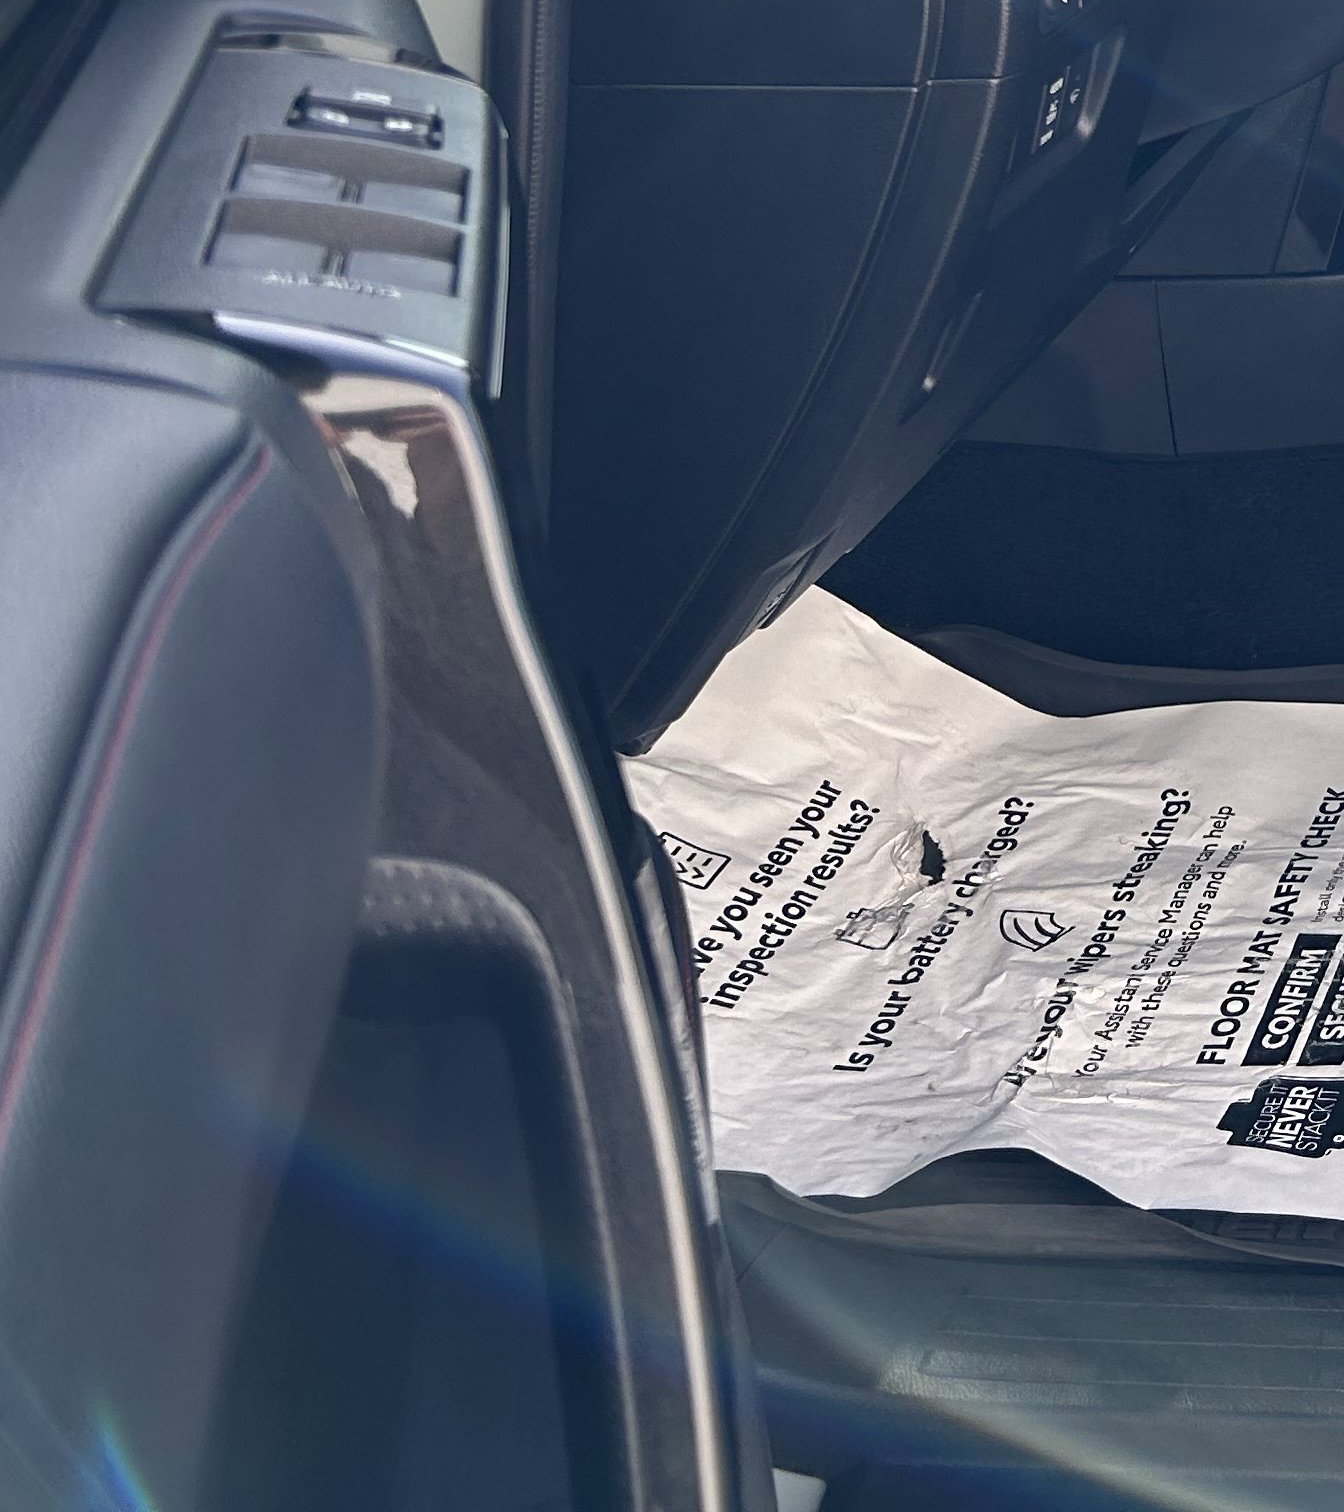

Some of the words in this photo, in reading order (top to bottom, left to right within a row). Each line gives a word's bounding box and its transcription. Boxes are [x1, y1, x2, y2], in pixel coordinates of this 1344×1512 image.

[709, 887, 763, 940] you
[749, 837, 804, 888] seen
[788, 780, 841, 839] your
[1196, 844, 1218, 862] can
[1203, 806, 1235, 838] help
[697, 890, 818, 1009] inspection
[803, 799, 880, 890] results?
[1064, 909, 1126, 974] wipers
[1112, 788, 1191, 902] streaking?
[1158, 863, 1203, 923] Manager
[833, 1052, 874, 1072] Is
[858, 991, 911, 1047] your
[887, 902, 973, 985] battery
[1125, 1016, 1155, 1047] with
[1141, 971, 1176, 1011] these
[1168, 903, 1211, 967] questions
[1203, 871, 1226, 899] and
[1196, 980, 1260, 1064] FLOOR
[1236, 930, 1282, 974] MAT
[1262, 852, 1319, 925] SAFETY
[1258, 945, 1328, 1050] CONFIRM
[1071, 1045, 1108, 1077] Your
[1245, 1095, 1284, 1143] SECURE
[1269, 1083, 1289, 1095] IT
[1264, 1086, 1319, 1148] NEVER
[1294, 1102, 1336, 1151] STACK
[1316, 1086, 1340, 1101] IT
